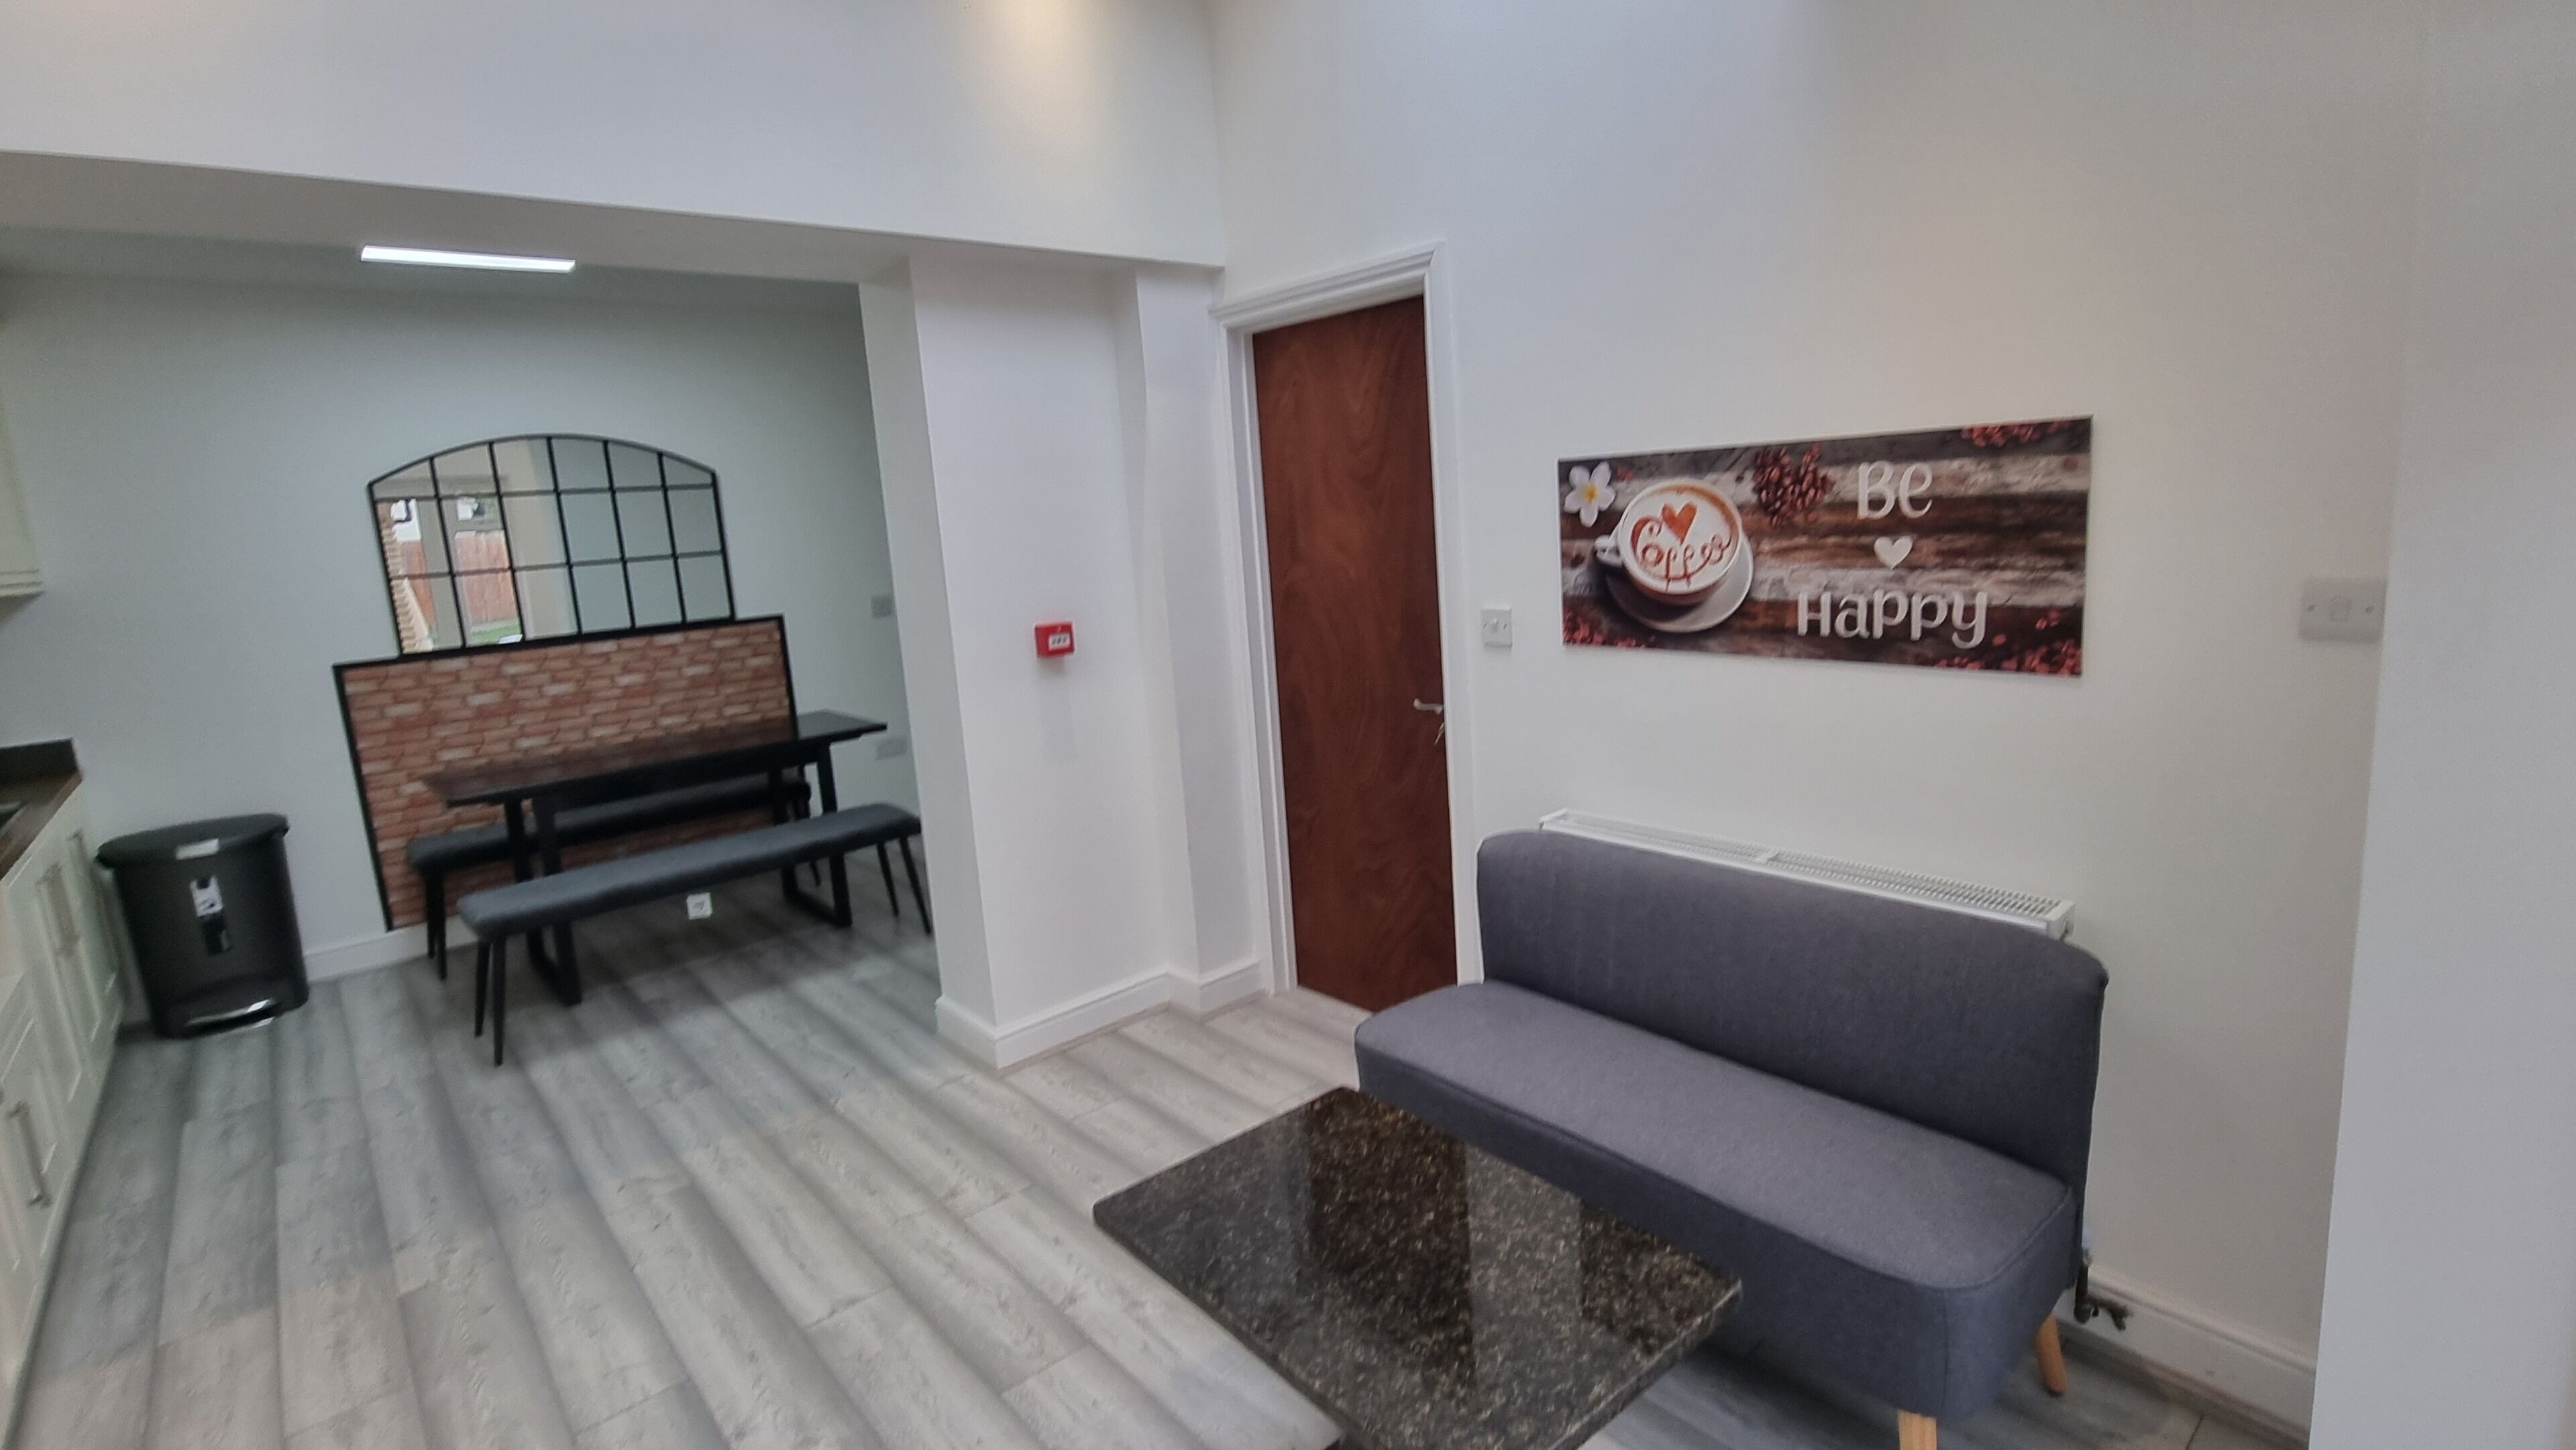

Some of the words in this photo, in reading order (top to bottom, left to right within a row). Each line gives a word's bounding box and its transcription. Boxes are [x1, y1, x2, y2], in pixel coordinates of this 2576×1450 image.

[1856, 460, 1933, 520] Be
[1630, 515, 1732, 592] Coffee
[1797, 588, 1988, 649] Happy
